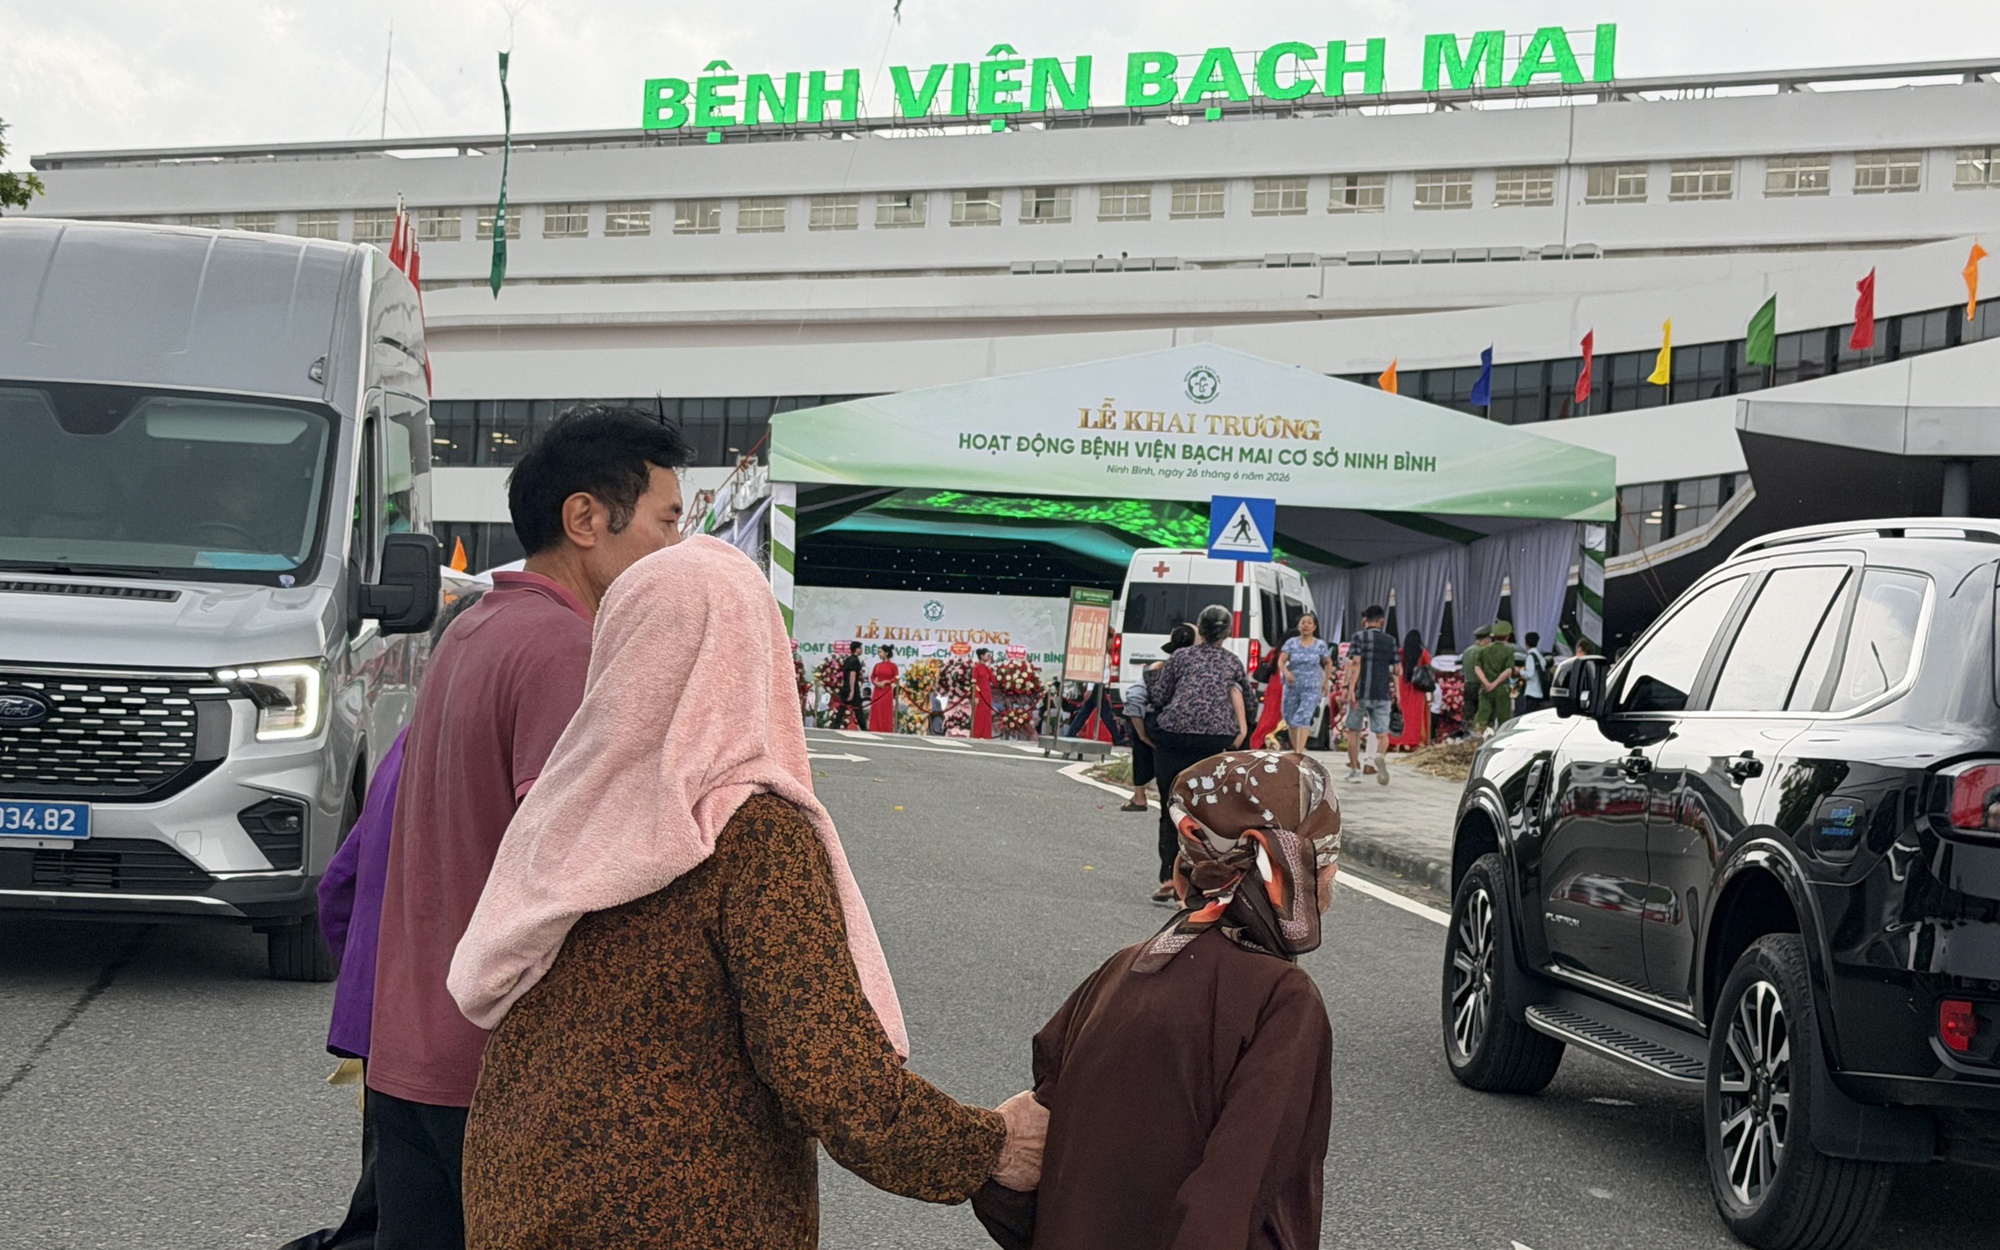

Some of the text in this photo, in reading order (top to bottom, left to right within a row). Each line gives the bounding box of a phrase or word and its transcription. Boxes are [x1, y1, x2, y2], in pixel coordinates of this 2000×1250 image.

[643, 25, 1615, 144] BỆNH VIỆN BẠCH MAI
[1078, 397, 1322, 441] LỄ KHAI TRƯƠNG
[958, 432, 1437, 473] HOẠT ĐỘNG BỆNH VIỆN BẠCH MAI CƠ SỞ NINH BÌNH
[1106, 464, 1291, 483] Ninh Bình, ngày 26 tháng 6 năm 2026
[855, 618, 1011, 645] LỄ KHAI TRƯƠNG
[895, 645, 919, 659] VIỆN
